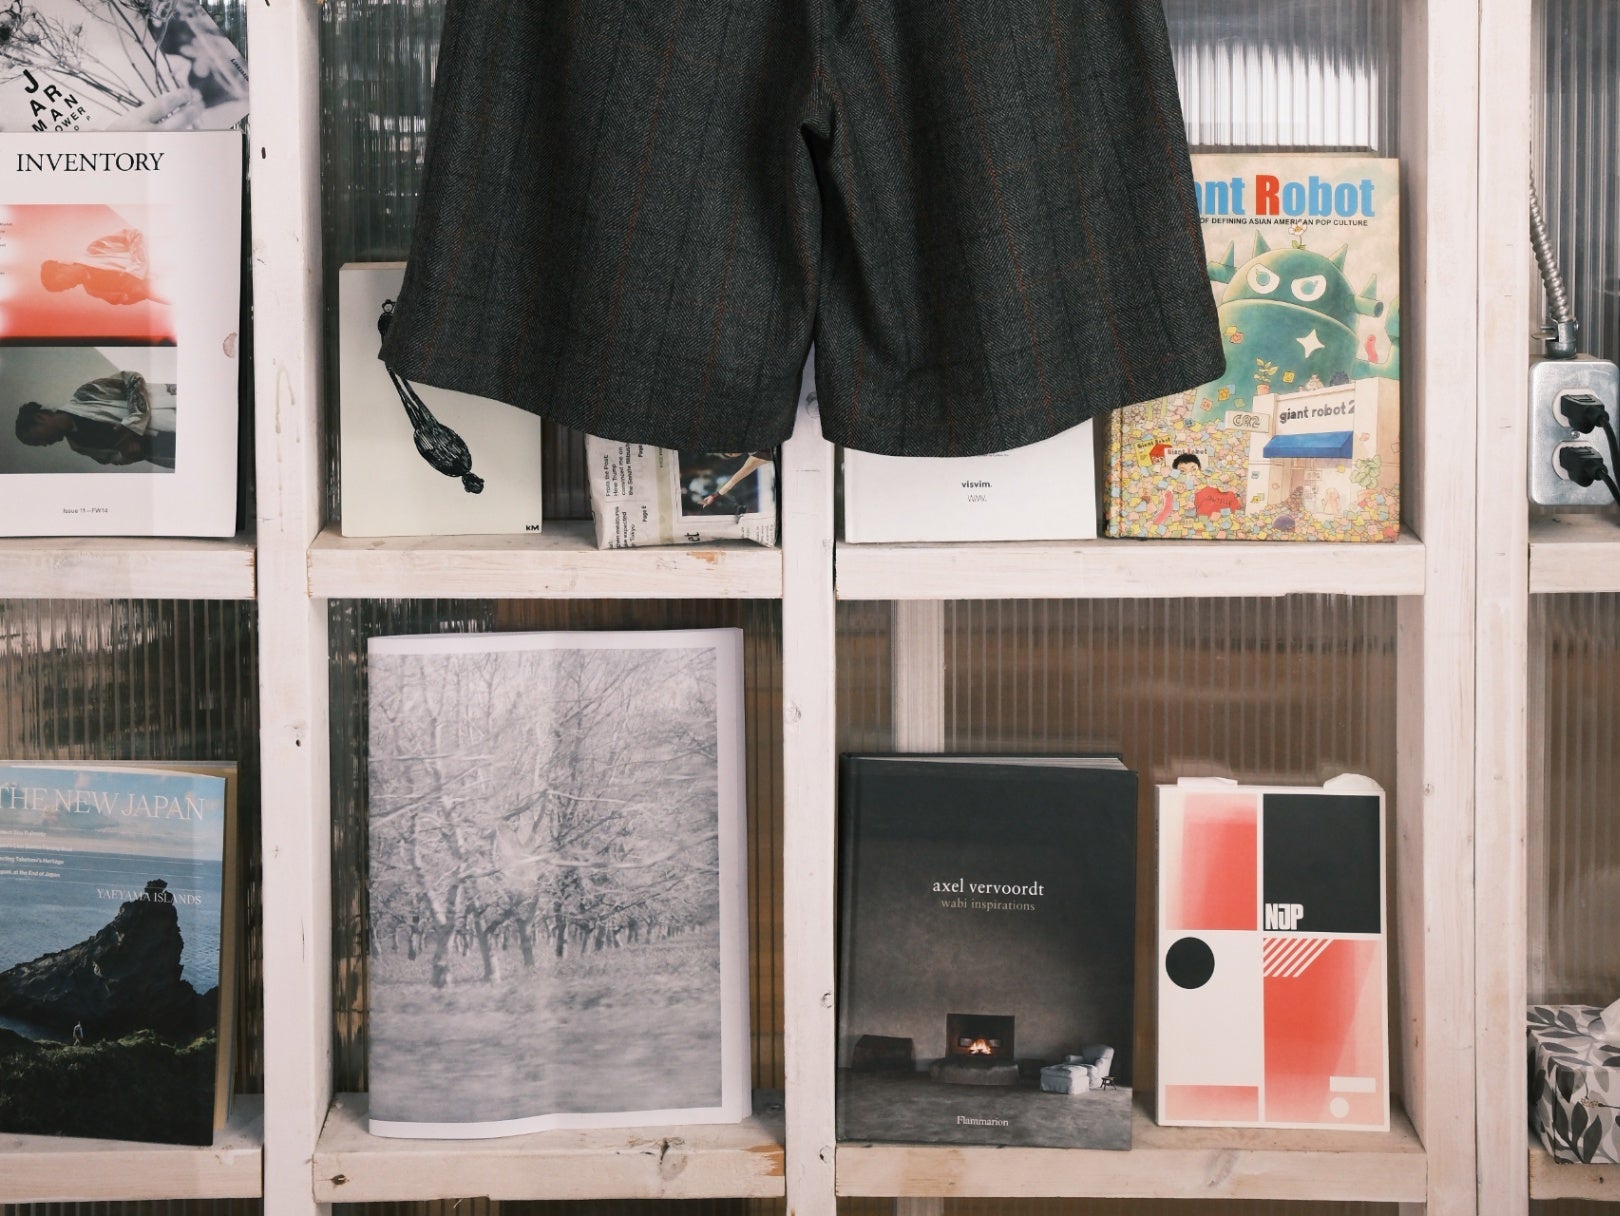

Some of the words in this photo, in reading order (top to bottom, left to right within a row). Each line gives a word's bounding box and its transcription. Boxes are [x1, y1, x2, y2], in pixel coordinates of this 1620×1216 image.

[16, 152, 165, 172] INVENTORY
[1256, 174, 1375, 217] Robot
[1212, 217, 1248, 225] DEFINING
[1333, 219, 1369, 227] CULTURE
[1280, 406, 1309, 424] giant
[1311, 402, 1346, 418] robot
[55, 788, 120, 815] NEW
[121, 793, 206, 821] JAPAN
[932, 877, 964, 893] axel
[969, 880, 1045, 896] vervoordt
[154, 891, 202, 905] ISLANDS
[941, 897, 967, 909] wabi
[971, 898, 1036, 912] inspirations
[1265, 902, 1304, 930] NJP
[956, 1115, 1009, 1127] Flammarion
